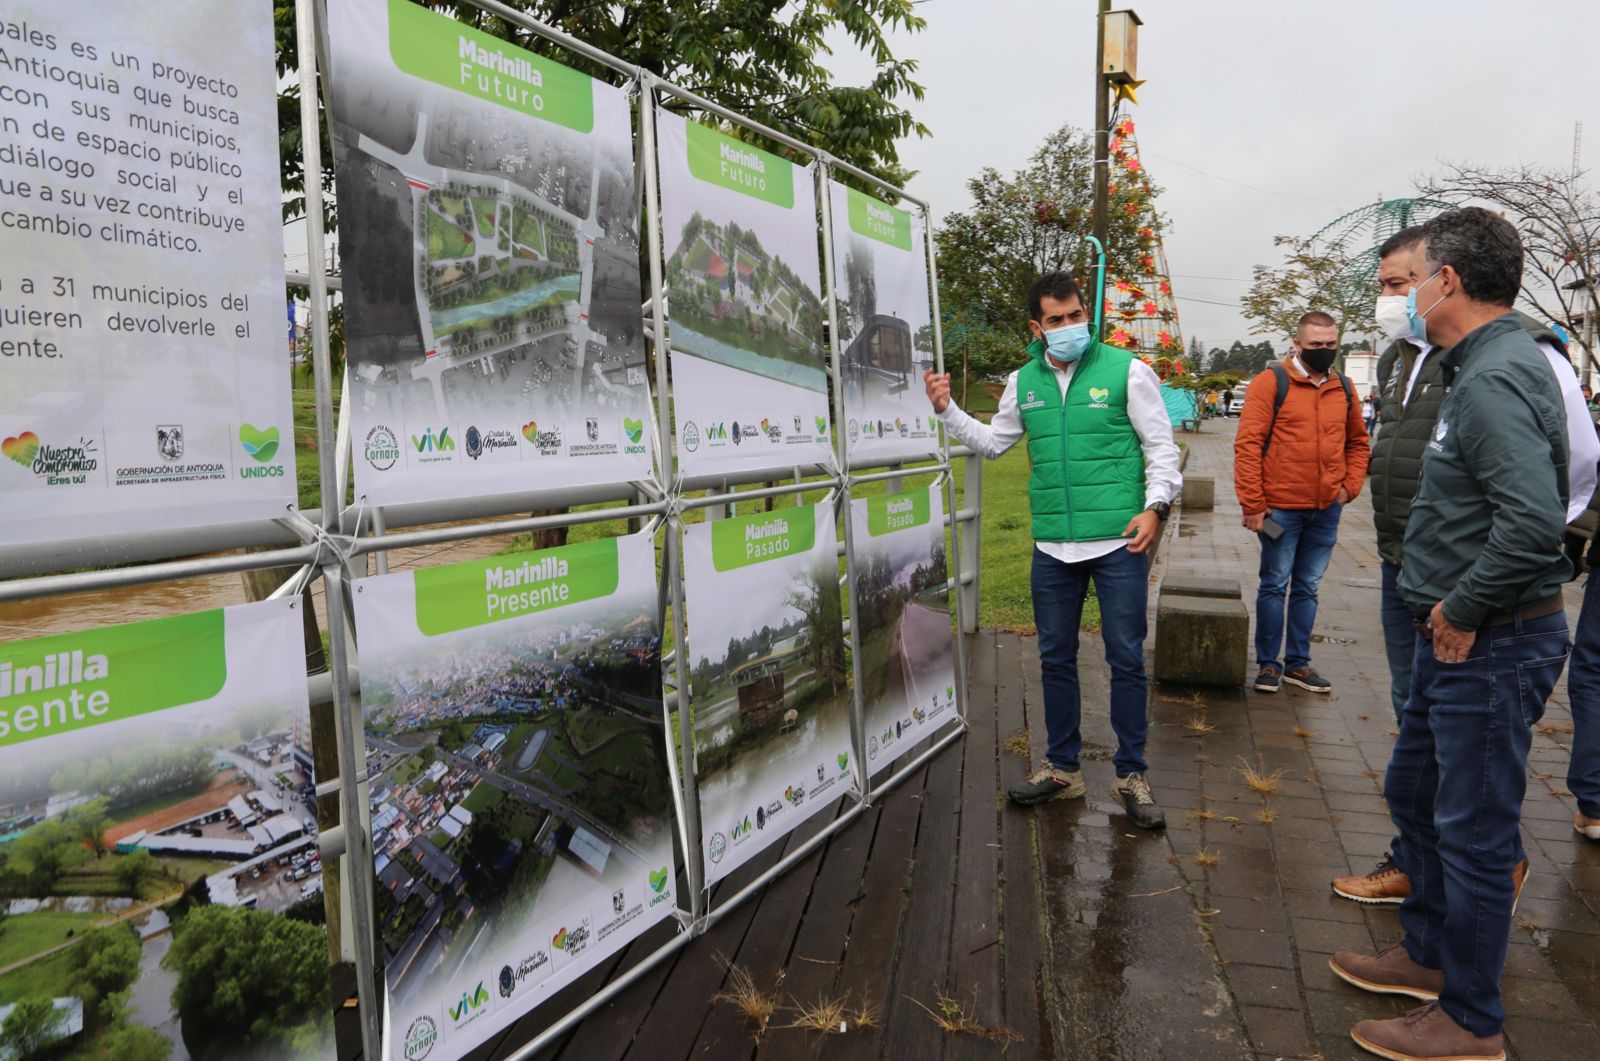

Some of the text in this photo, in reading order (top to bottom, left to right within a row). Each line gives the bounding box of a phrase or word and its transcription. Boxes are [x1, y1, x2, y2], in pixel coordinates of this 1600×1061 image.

[71, 41, 98, 61] es
[111, 51, 141, 72] un
[152, 60, 239, 99] proyecto
[458, 35, 543, 88] Marinilla
[0, 47, 240, 126] Antioquia que busca
[460, 62, 544, 111] Futuro
[0, 85, 242, 154] con sus municipios,
[32, 119, 65, 142] de
[76, 130, 161, 163] espacio
[170, 150, 242, 178] público
[720, 142, 765, 174] Marinilla
[0, 144, 244, 205] diálogo social y el
[720, 161, 766, 191] Futuro
[39, 185, 53, 202] a
[61, 188, 86, 207] su
[94, 194, 131, 215] vez
[137, 202, 245, 233] contribuye
[1, 210, 202, 253] cambio climático.
[21, 278, 34, 294] a
[53, 276, 74, 297] 31
[93, 283, 208, 309] municipios
[221, 292, 249, 312] del
[0, 304, 250, 338] uieren devolverle el
[1, 338, 63, 358] ente.
[33, 459, 97, 475] Compromiso
[364, 447, 400, 461] Cornare
[624, 446, 646, 454] UNIDOS
[116, 463, 224, 477] GOBERNACIÓN DE ANTIOQUIA
[240, 465, 284, 478] UNIDOS
[745, 518, 788, 541] Marinilla
[887, 511, 914, 529] Pasado
[746, 537, 790, 560] Pasado
[485, 556, 568, 592] Marinilla
[486, 582, 569, 617] Presente
[0, 650, 108, 698] inilla
[649, 890, 671, 907] UNIDOS
